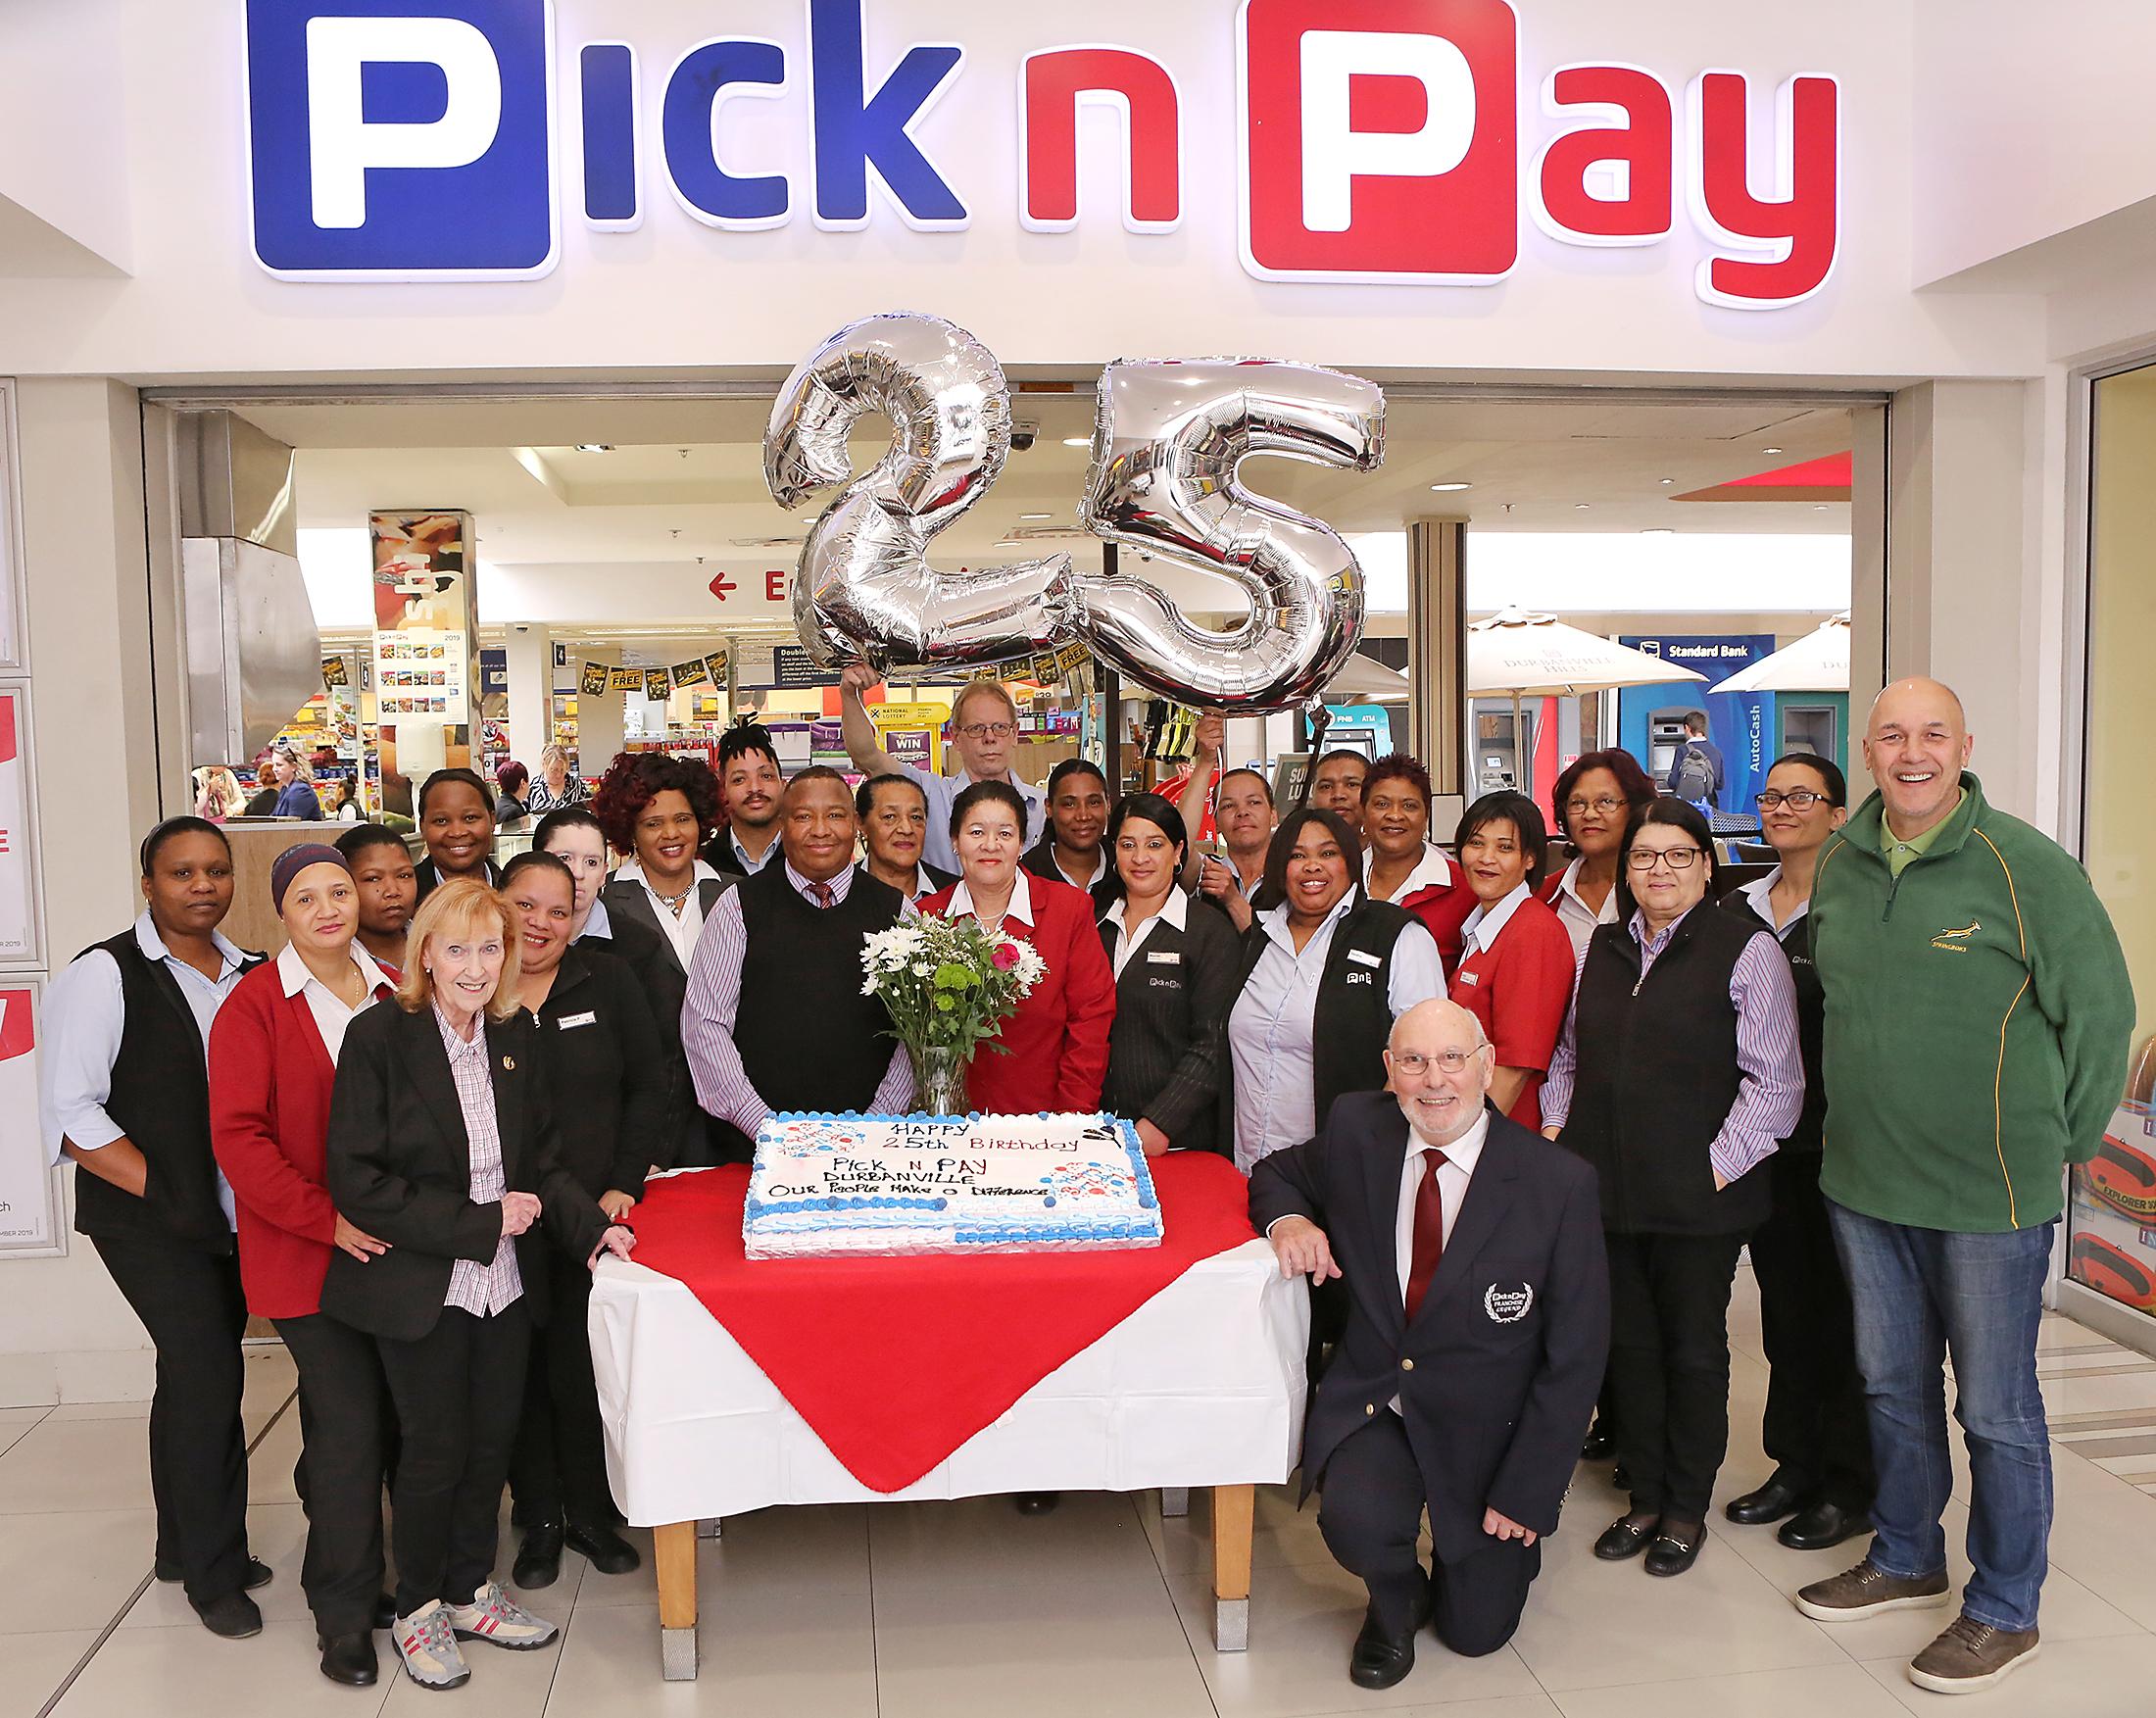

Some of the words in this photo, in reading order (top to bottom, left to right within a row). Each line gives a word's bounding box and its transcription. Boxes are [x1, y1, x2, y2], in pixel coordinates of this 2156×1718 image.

[247, 0, 970, 282] Pick
[1017, 45, 1184, 233] n
[1237, 0, 1840, 311] Pay
[1062, 647, 1086, 666] FREE
[1669, 645, 1719, 658] Standard
[1720, 645, 1748, 658] Bank
[612, 676, 640, 686] FREE
[896, 739, 921, 749] WIN
[1749, 705, 1760, 772] AutoCash
[891, 1123, 969, 1136] HAPPY
[882, 1137, 949, 1149] 25th
[909, 1160, 921, 1170] N
[937, 1157, 987, 1175] PAY
[823, 1172, 975, 1185] DURBANVILLE
[768, 1185, 819, 1197] OUR
[2104, 1186, 2147, 1209] EXPLORER
